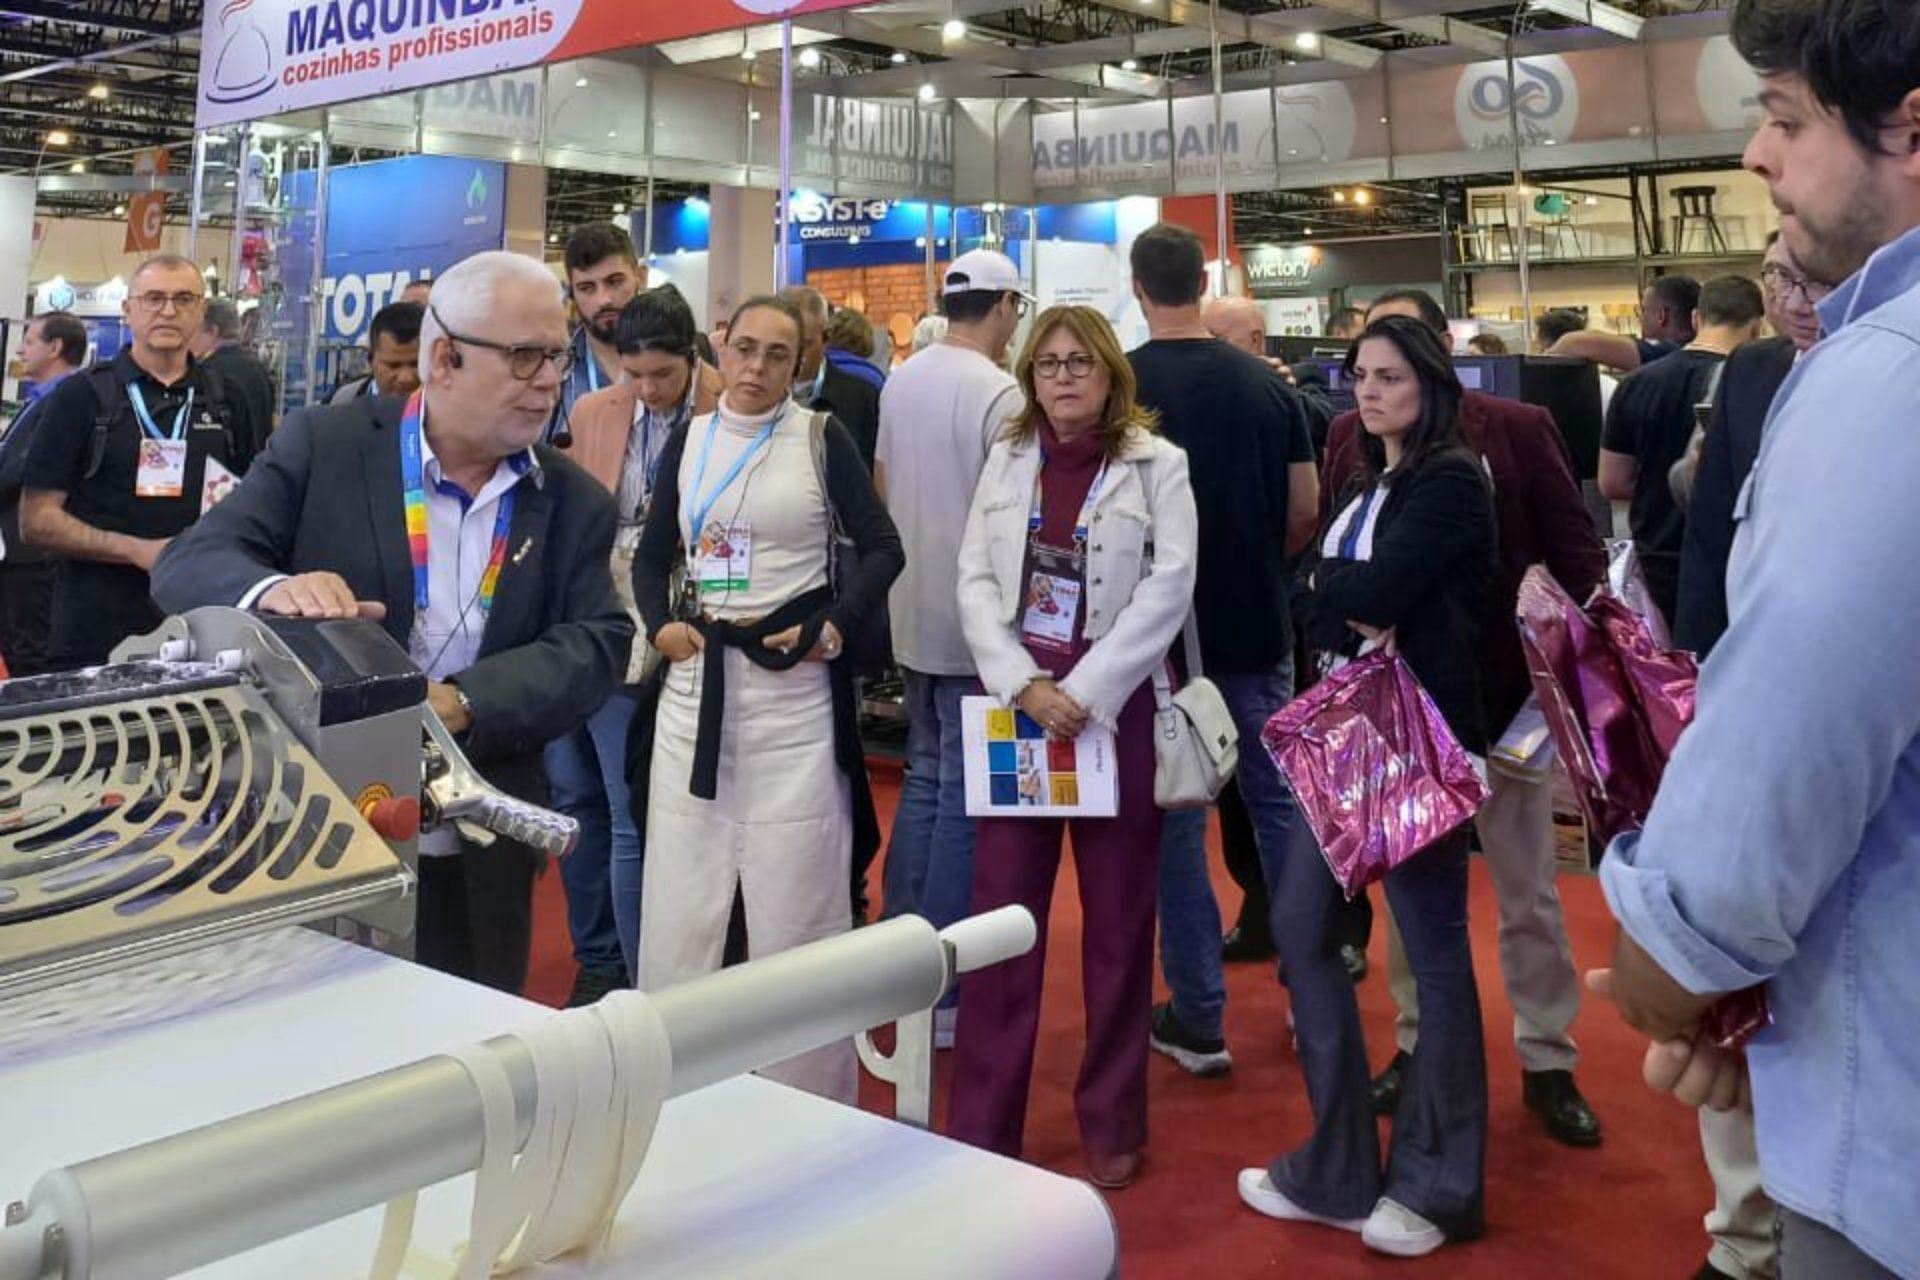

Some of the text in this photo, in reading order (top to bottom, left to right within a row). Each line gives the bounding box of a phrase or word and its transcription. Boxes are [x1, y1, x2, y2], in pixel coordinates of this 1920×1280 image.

[283, 6, 553, 86] cozinhas profissionais
[286, 0, 537, 56] MAQUIN
[143, 202, 161, 238] G
[320, 268, 431, 336] TOT
